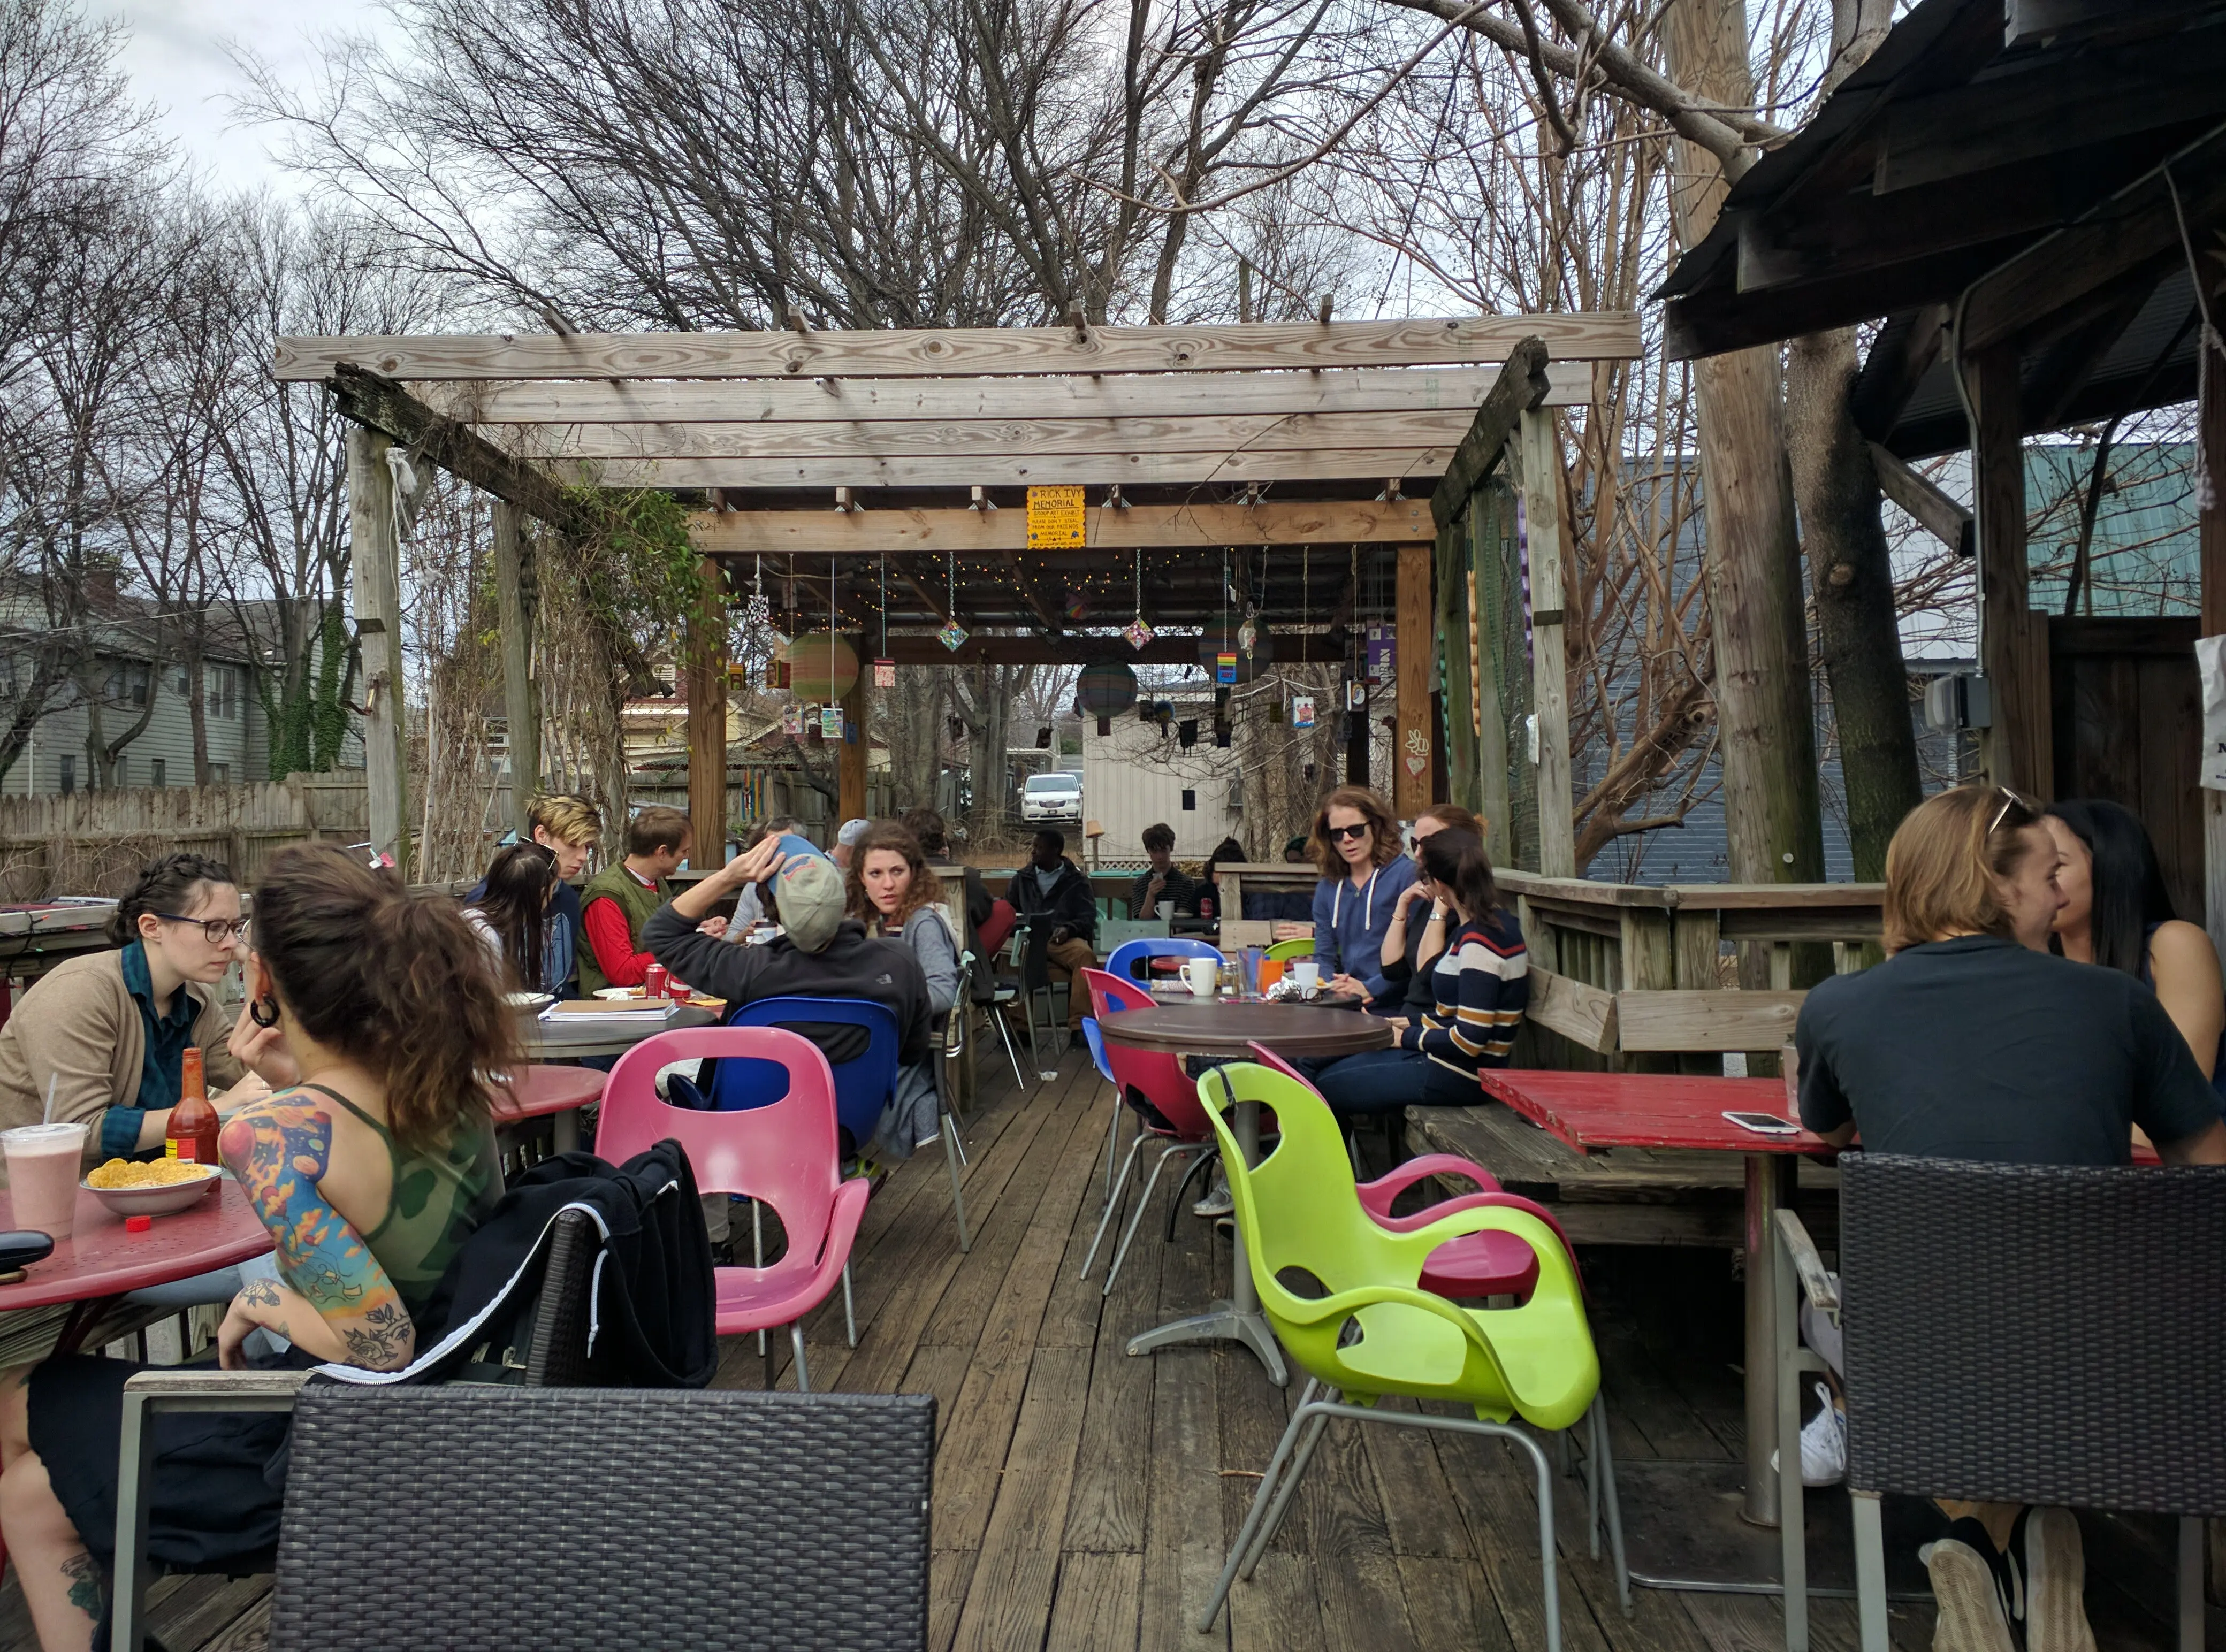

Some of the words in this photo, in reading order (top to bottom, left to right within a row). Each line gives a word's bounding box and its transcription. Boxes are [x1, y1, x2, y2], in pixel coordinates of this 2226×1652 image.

[1040, 488, 1061, 499] RICK
[1064, 488, 1081, 498] IVY
[1033, 499, 1074, 509] MEMORIAL
